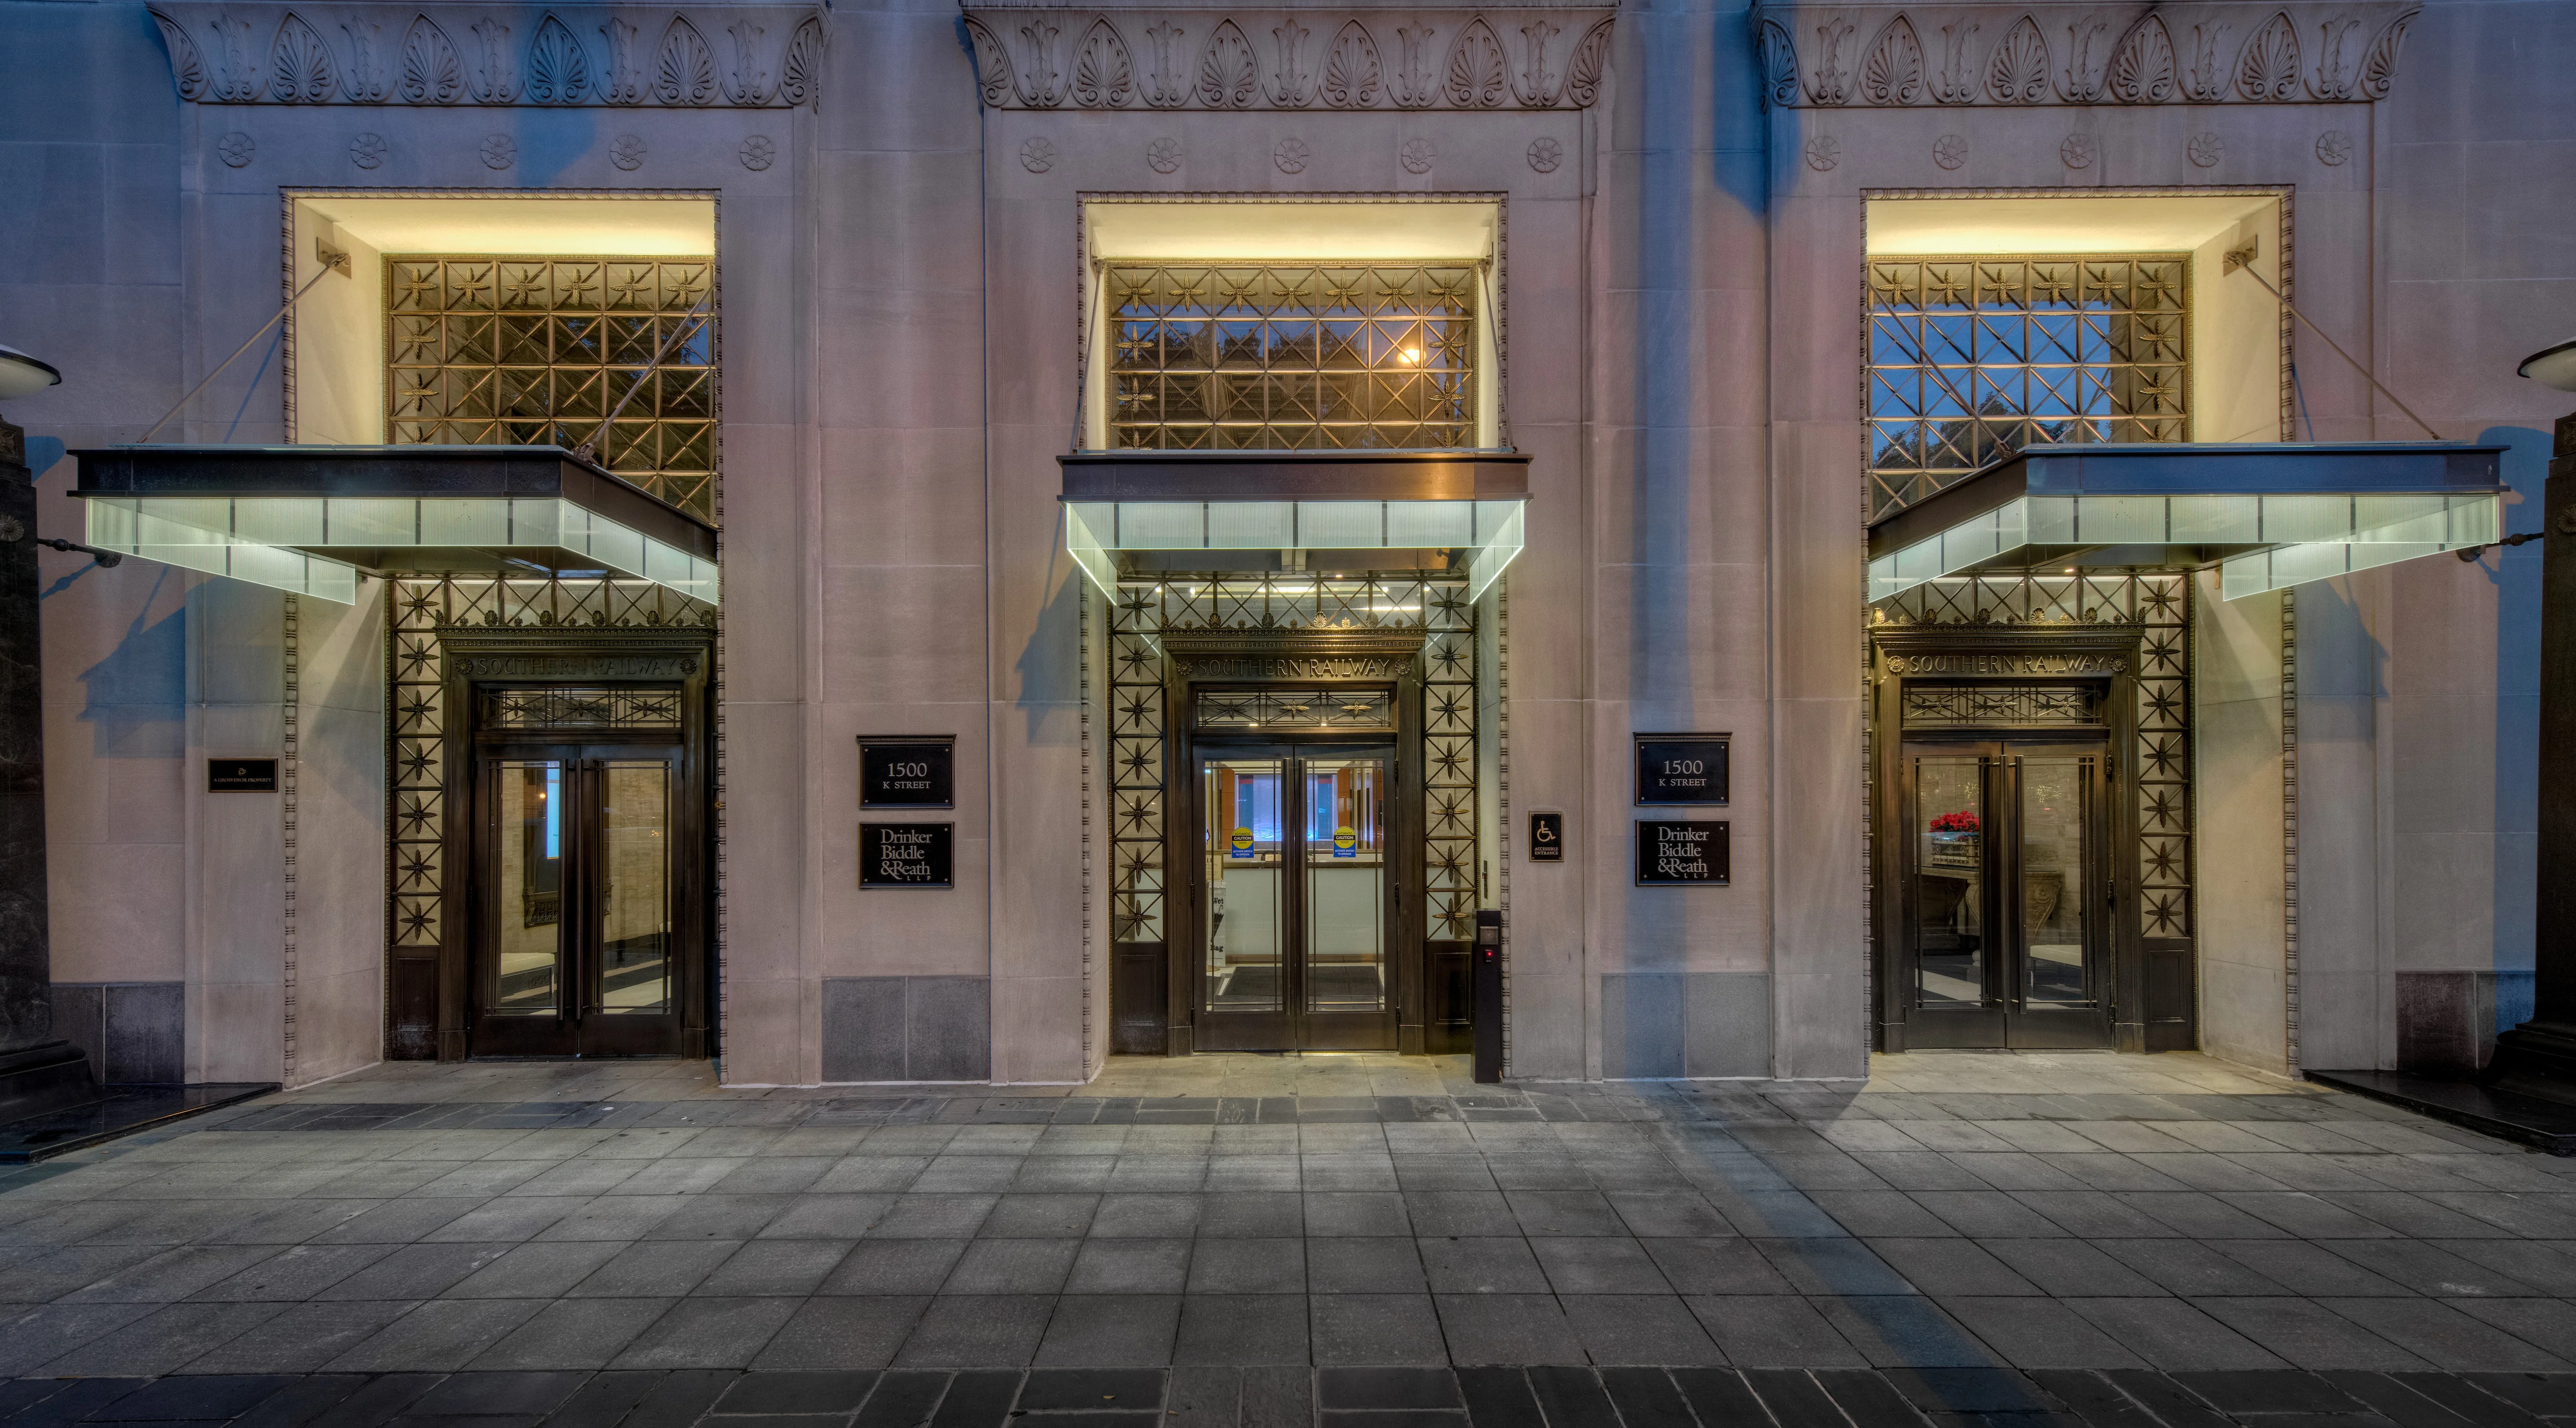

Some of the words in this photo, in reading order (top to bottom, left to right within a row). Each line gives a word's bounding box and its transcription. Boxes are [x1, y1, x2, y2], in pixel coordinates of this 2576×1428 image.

[478, 658, 586, 674] SOUTHERN
[593, 658, 677, 674] RAILWAY
[1198, 659, 1302, 676] SOUTHERN
[1309, 658, 1391, 675] RAILWAY
[1909, 655, 2016, 672] SOUTHERN
[2023, 654, 2105, 672] RAILWAY
[888, 763, 927, 777] 1500
[1664, 760, 1703, 774] 1500
[881, 829, 932, 843] Drinker
[1658, 827, 1709, 841] Drinker
[881, 845, 925, 859] Biddle
[1658, 843, 1701, 857] Biddle
[881, 861, 931, 880] &Reath
[1658, 858, 1708, 877] &Reath
